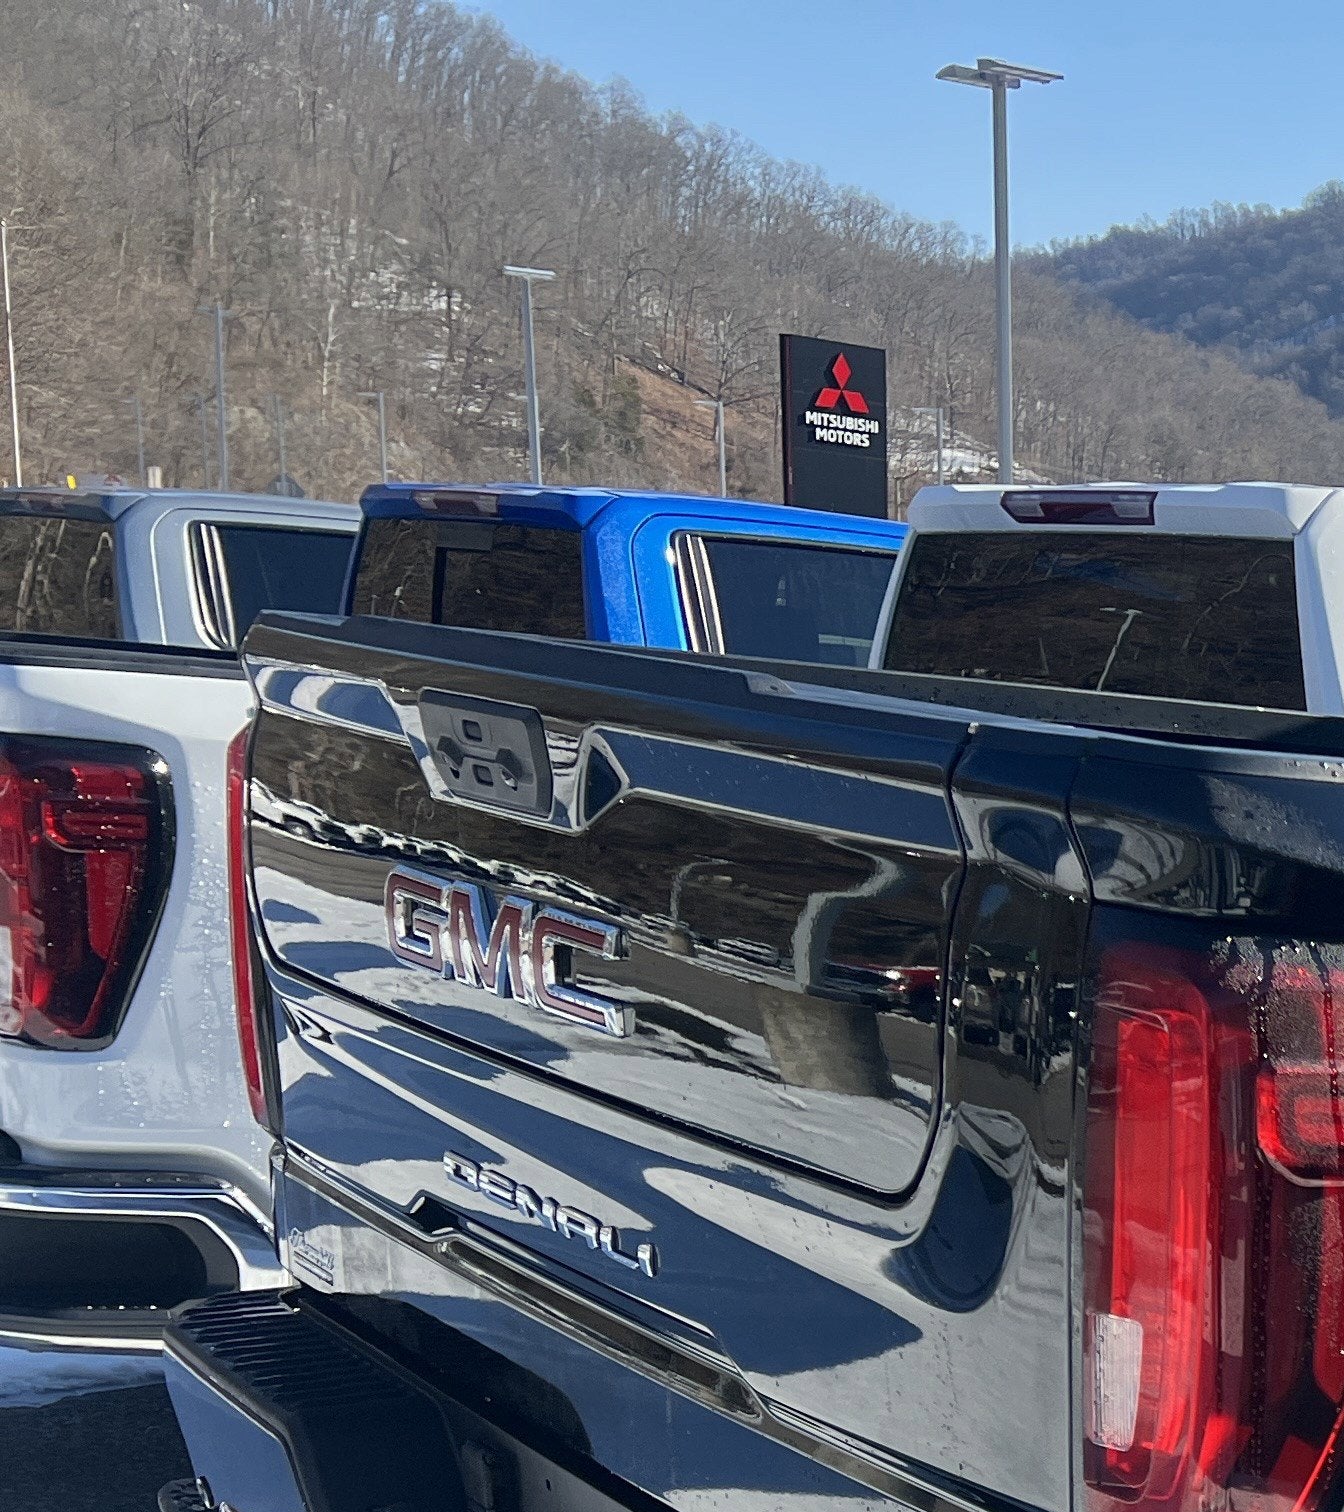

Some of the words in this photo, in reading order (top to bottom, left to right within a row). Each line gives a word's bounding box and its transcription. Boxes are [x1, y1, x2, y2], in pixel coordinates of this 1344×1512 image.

[805, 410, 879, 434] MITSUBISHI
[815, 427, 870, 448] MOTORS
[383, 863, 637, 1039] GMC
[442, 1149, 662, 1279] DENALI
